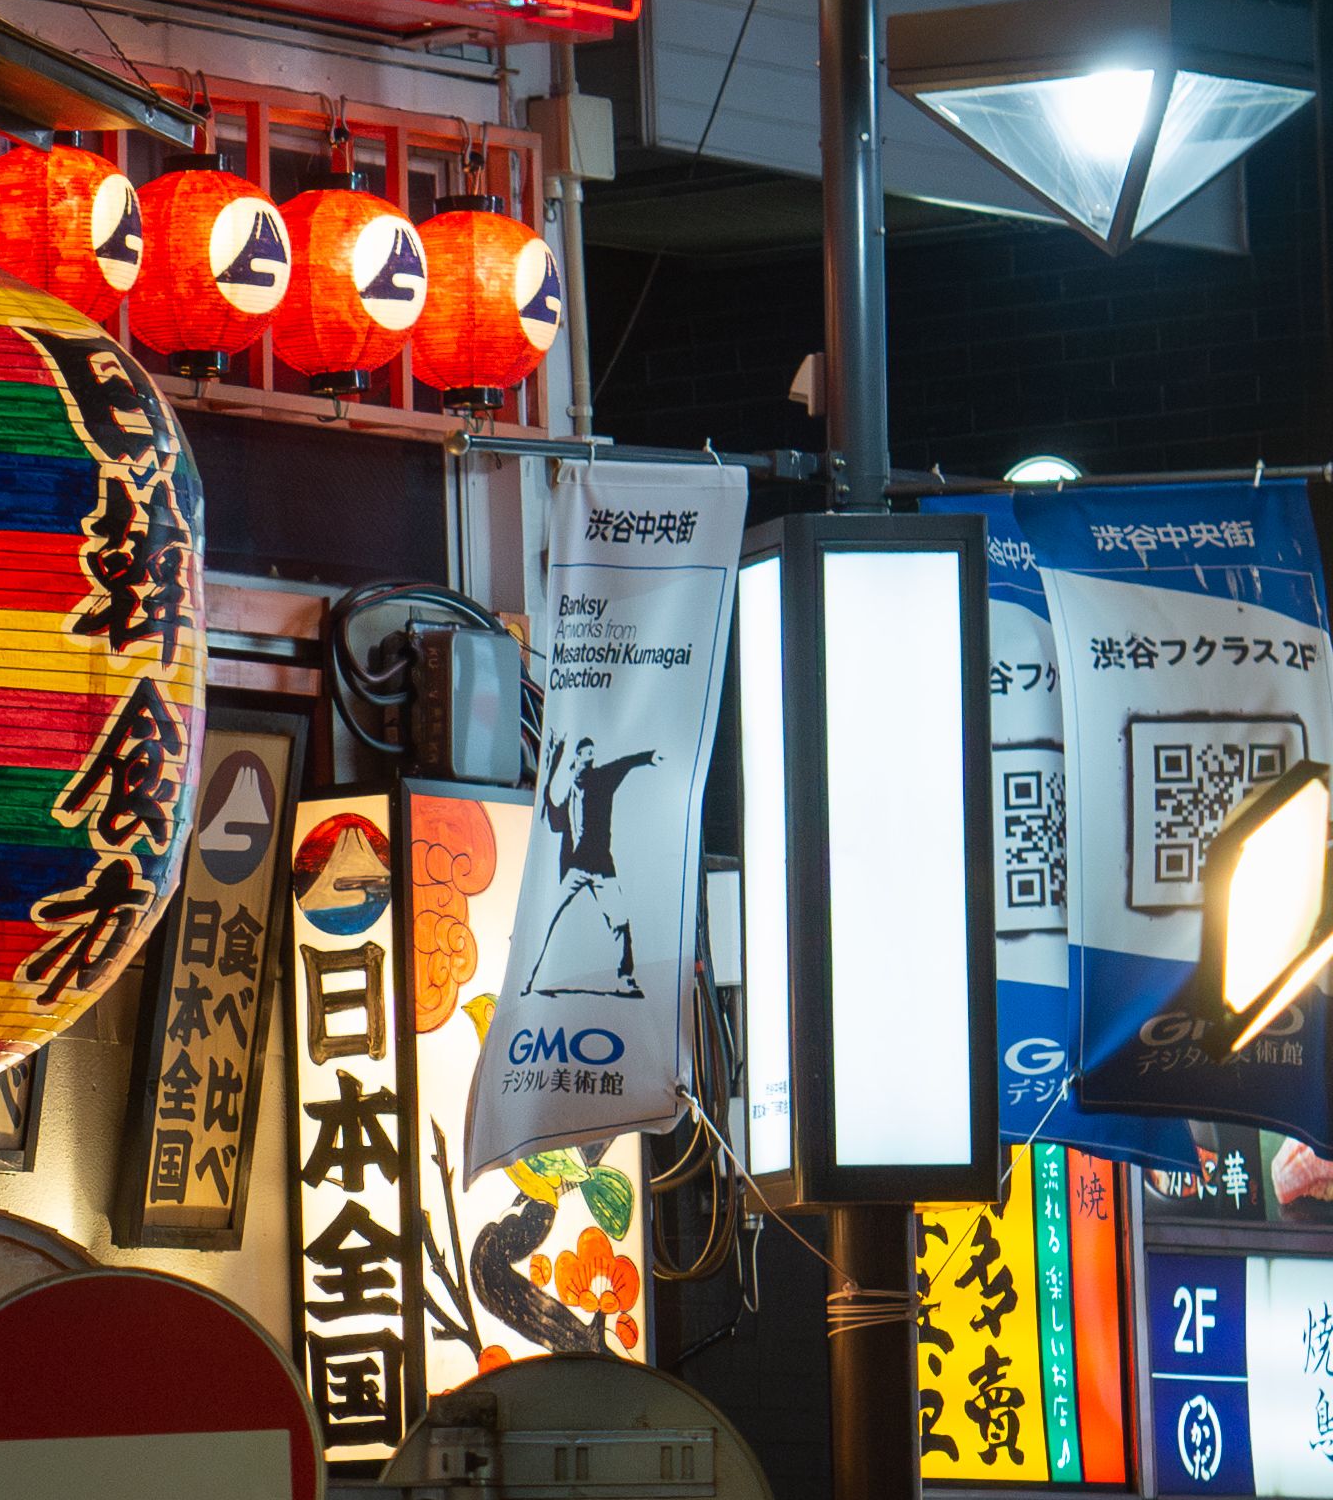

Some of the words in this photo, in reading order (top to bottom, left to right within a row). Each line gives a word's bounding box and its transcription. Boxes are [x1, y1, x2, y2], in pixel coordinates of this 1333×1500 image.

[585, 508, 698, 544] 渋谷中央街
[1090, 520, 1256, 551] 渋谷中央街
[559, 594, 608, 620] Banksy
[604, 619, 637, 639] from
[551, 642, 623, 665] Masatoshi
[621, 643, 692, 671] Kumagai
[549, 666, 612, 691] Collection
[148, 896, 222, 1206] 日本全国
[193, 905, 262, 1209] 食べ比べ
[508, 1026, 624, 1066] GMO
[501, 1066, 624, 1098] デジタル美術館
[300, 941, 406, 1451] 日本全国
[1173, 1286, 1218, 1355] 2F
[1188, 1394, 1215, 1482] つかだ
